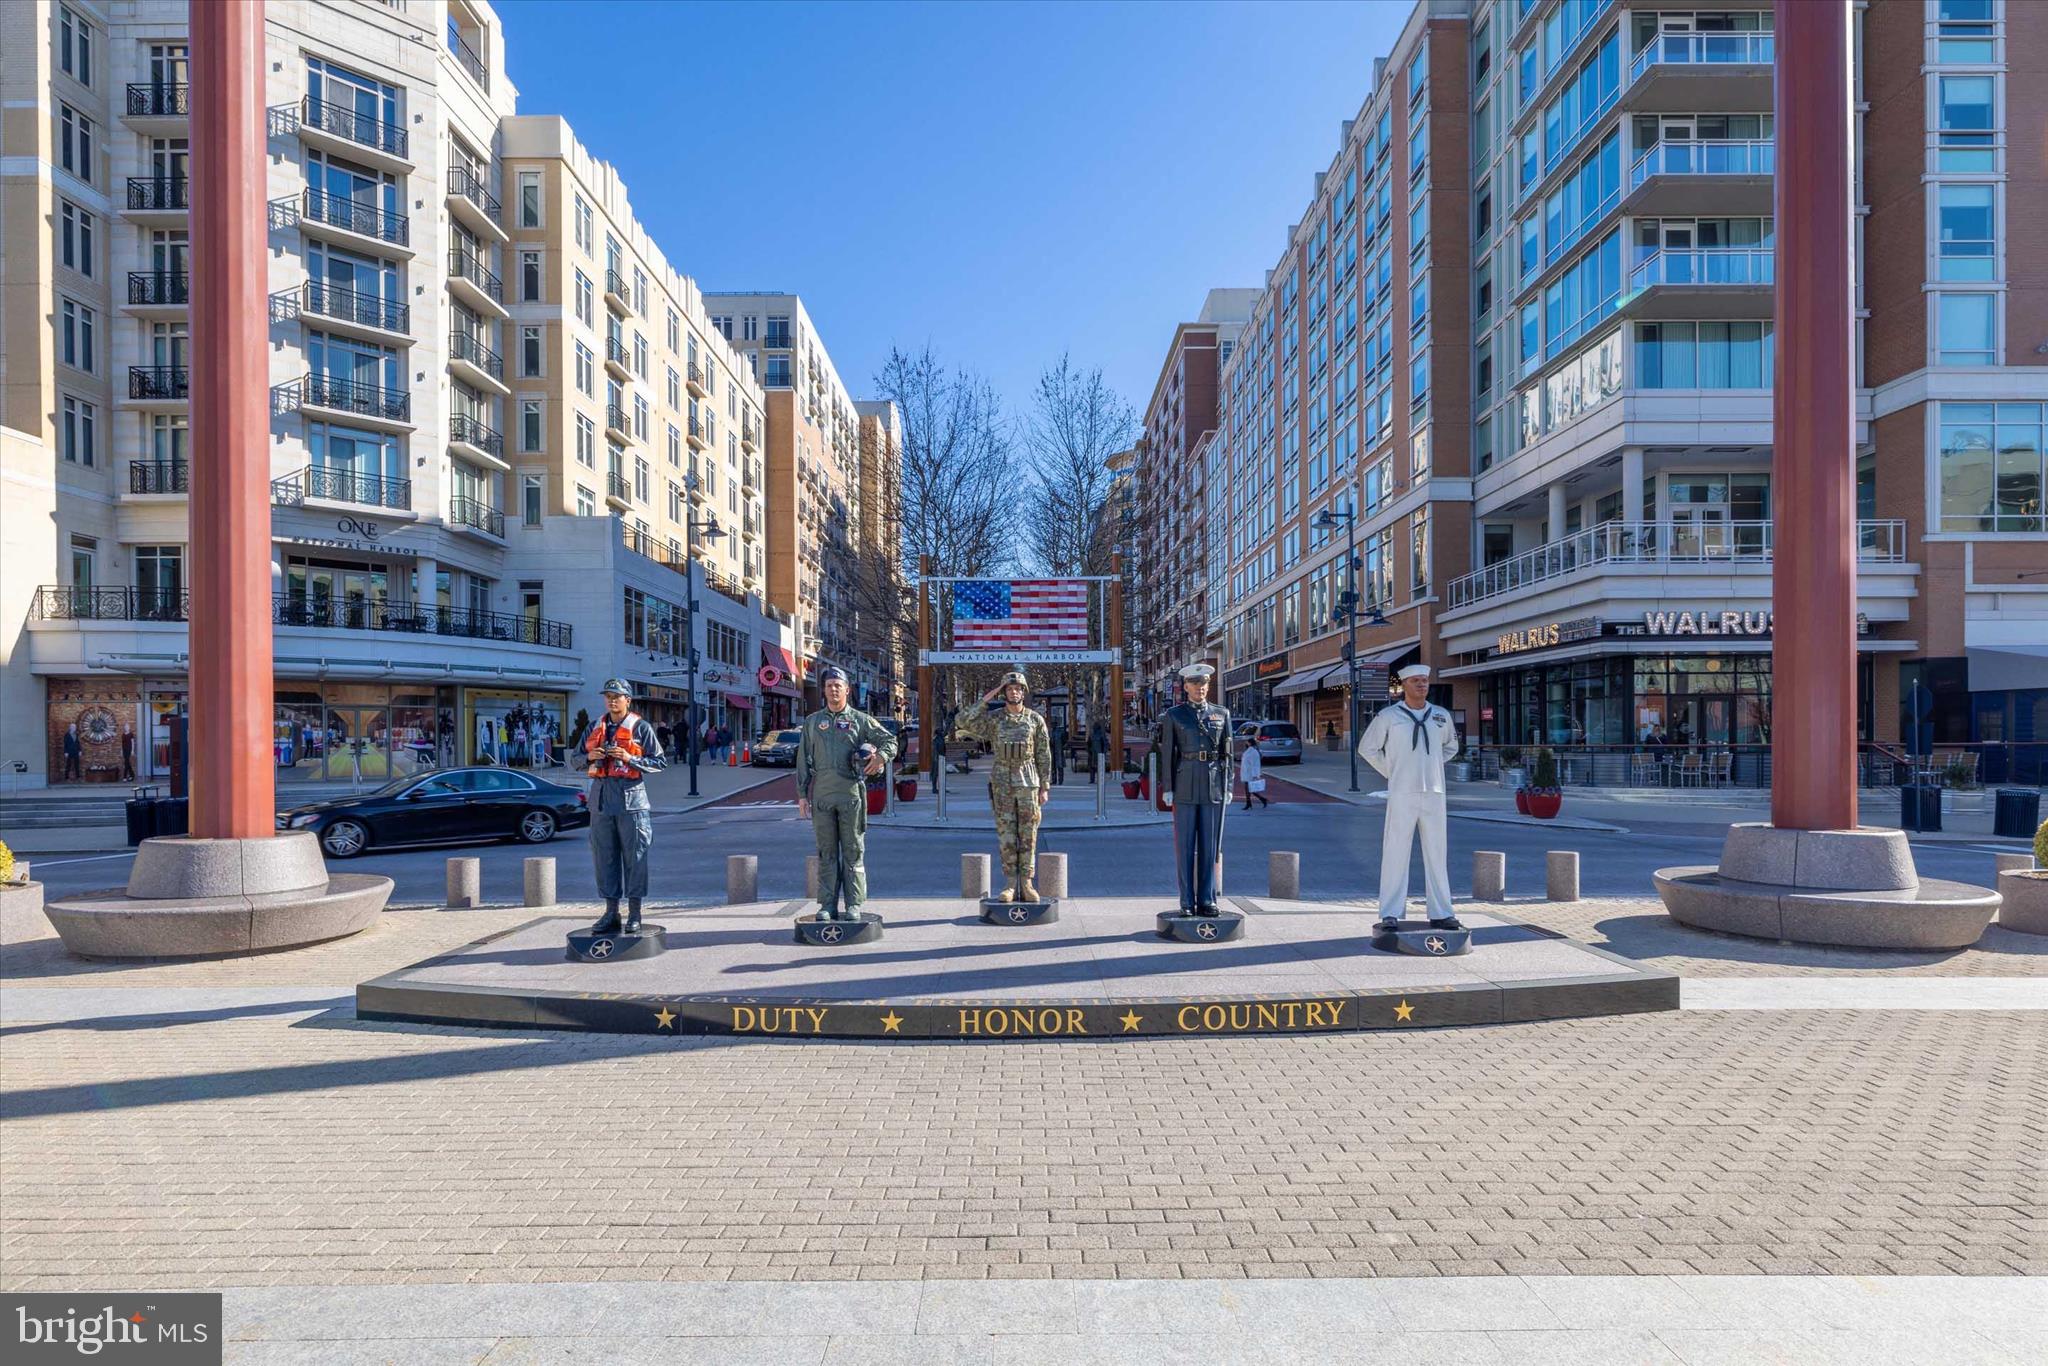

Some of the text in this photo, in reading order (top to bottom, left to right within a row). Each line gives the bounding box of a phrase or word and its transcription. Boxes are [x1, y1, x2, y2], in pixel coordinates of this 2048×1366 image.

[337, 515, 379, 540] ONE
[293, 536, 419, 556] NATIONAL HARBOR
[1616, 624, 1645, 636] THE
[1645, 611, 1773, 636] WALRU
[1497, 622, 1560, 655] WALRUS
[958, 652, 1083, 661] NATIONAL HARBOR
[914, 996, 1160, 1006] PROTECTING
[732, 1001, 1346, 1035] DUTY HONOR COUNTRY
